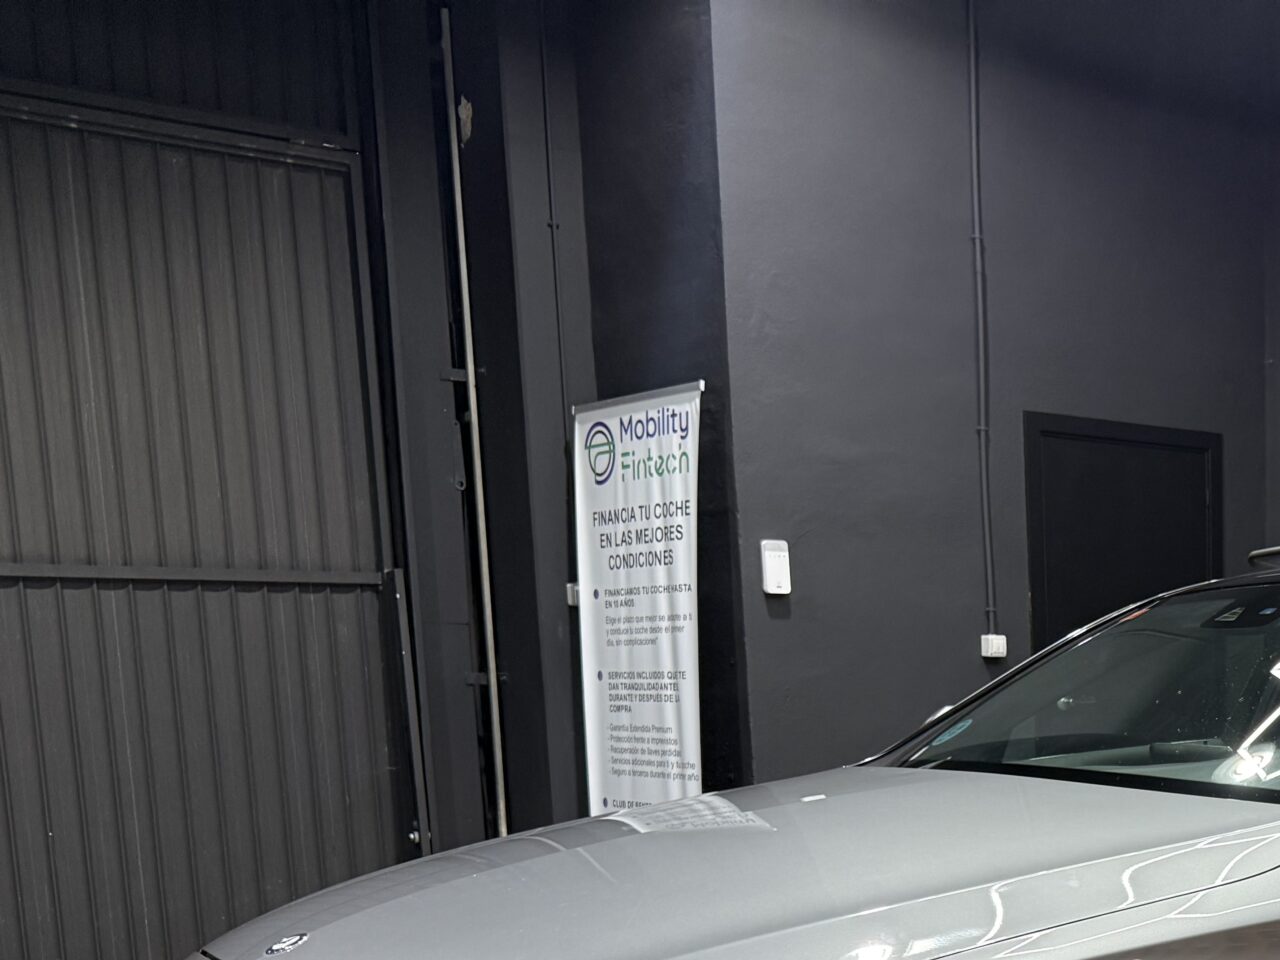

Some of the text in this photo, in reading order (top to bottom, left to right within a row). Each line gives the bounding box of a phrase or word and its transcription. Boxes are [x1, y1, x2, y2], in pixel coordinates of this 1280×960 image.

[619, 407, 690, 443] Mobility
[621, 443, 690, 482] Fintech
[593, 499, 691, 527] FINANCIA TU COCHE
[600, 524, 684, 549] EN LAS MEJORES
[608, 549, 674, 571] CONDICIONES
[604, 587, 640, 597] FINANCIAMOS
[642, 586, 649, 594] TU
[605, 600, 612, 609] EN
[620, 598, 634, 608] AÑOS
[608, 671, 635, 680] SERVICIOS
[636, 671, 665, 680] INCLUIDOS
[608, 682, 619, 691] DAN
[620, 682, 659, 691] TRANQUILIDAD
[609, 694, 633, 702] DURANTE
[664, 694, 674, 702] DE
[609, 705, 632, 713] COMPRA
[612, 800, 626, 808] CLUB
